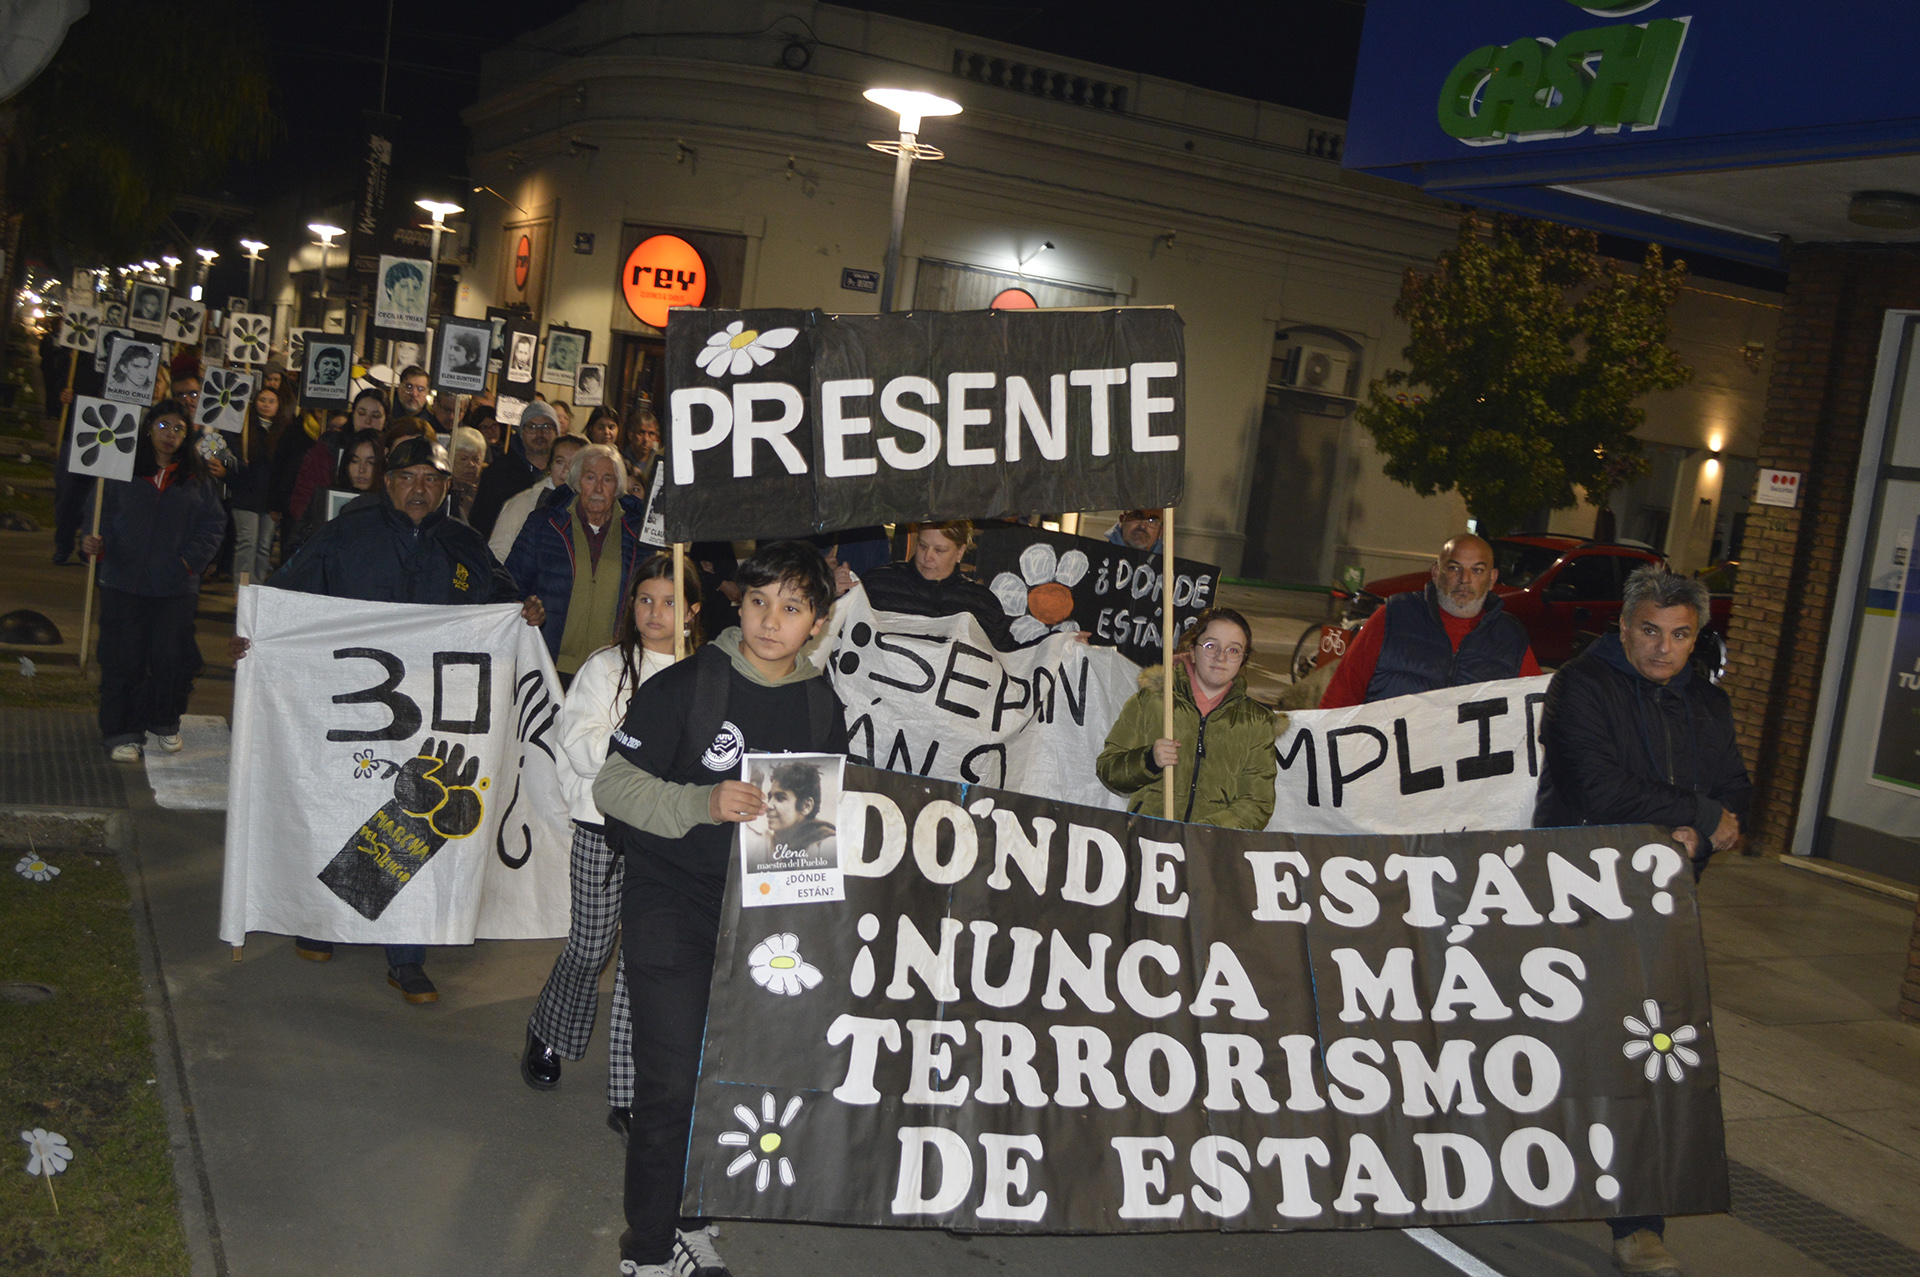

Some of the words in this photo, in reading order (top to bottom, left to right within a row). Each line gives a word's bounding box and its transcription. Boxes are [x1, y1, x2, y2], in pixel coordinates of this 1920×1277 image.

[1438, 16, 1692, 147] CASH
[632, 265, 696, 291] rey
[378, 311, 404, 321] CECILIA
[405, 314, 424, 324] TRIAS
[107, 387, 130, 397] MARIO
[131, 390, 151, 400] CRUZ
[441, 372, 455, 380] ELENA
[456, 374, 481, 384] QUINTEROS
[671, 361, 1180, 486] PRESENTE
[326, 647, 491, 742] 30
[359, 825, 378, 844] DEL
[372, 810, 430, 861] MARCHA
[756, 861, 787, 870] maestra
[788, 859, 800, 868] del
[801, 857, 828, 868] Pueblo
[786, 872, 827, 886] ¿DÓNDE
[797, 885, 835, 898] ESTÁN?
[1244, 843, 1683, 927] ESTÁN?
[850, 913, 1270, 1022] ¡NUNCA
[1330, 924, 1587, 1022] MÁS
[827, 1013, 1561, 1117] TERRORISMO
[891, 1125, 1048, 1222] DE
[1111, 1123, 1620, 1221] ESTADO!
